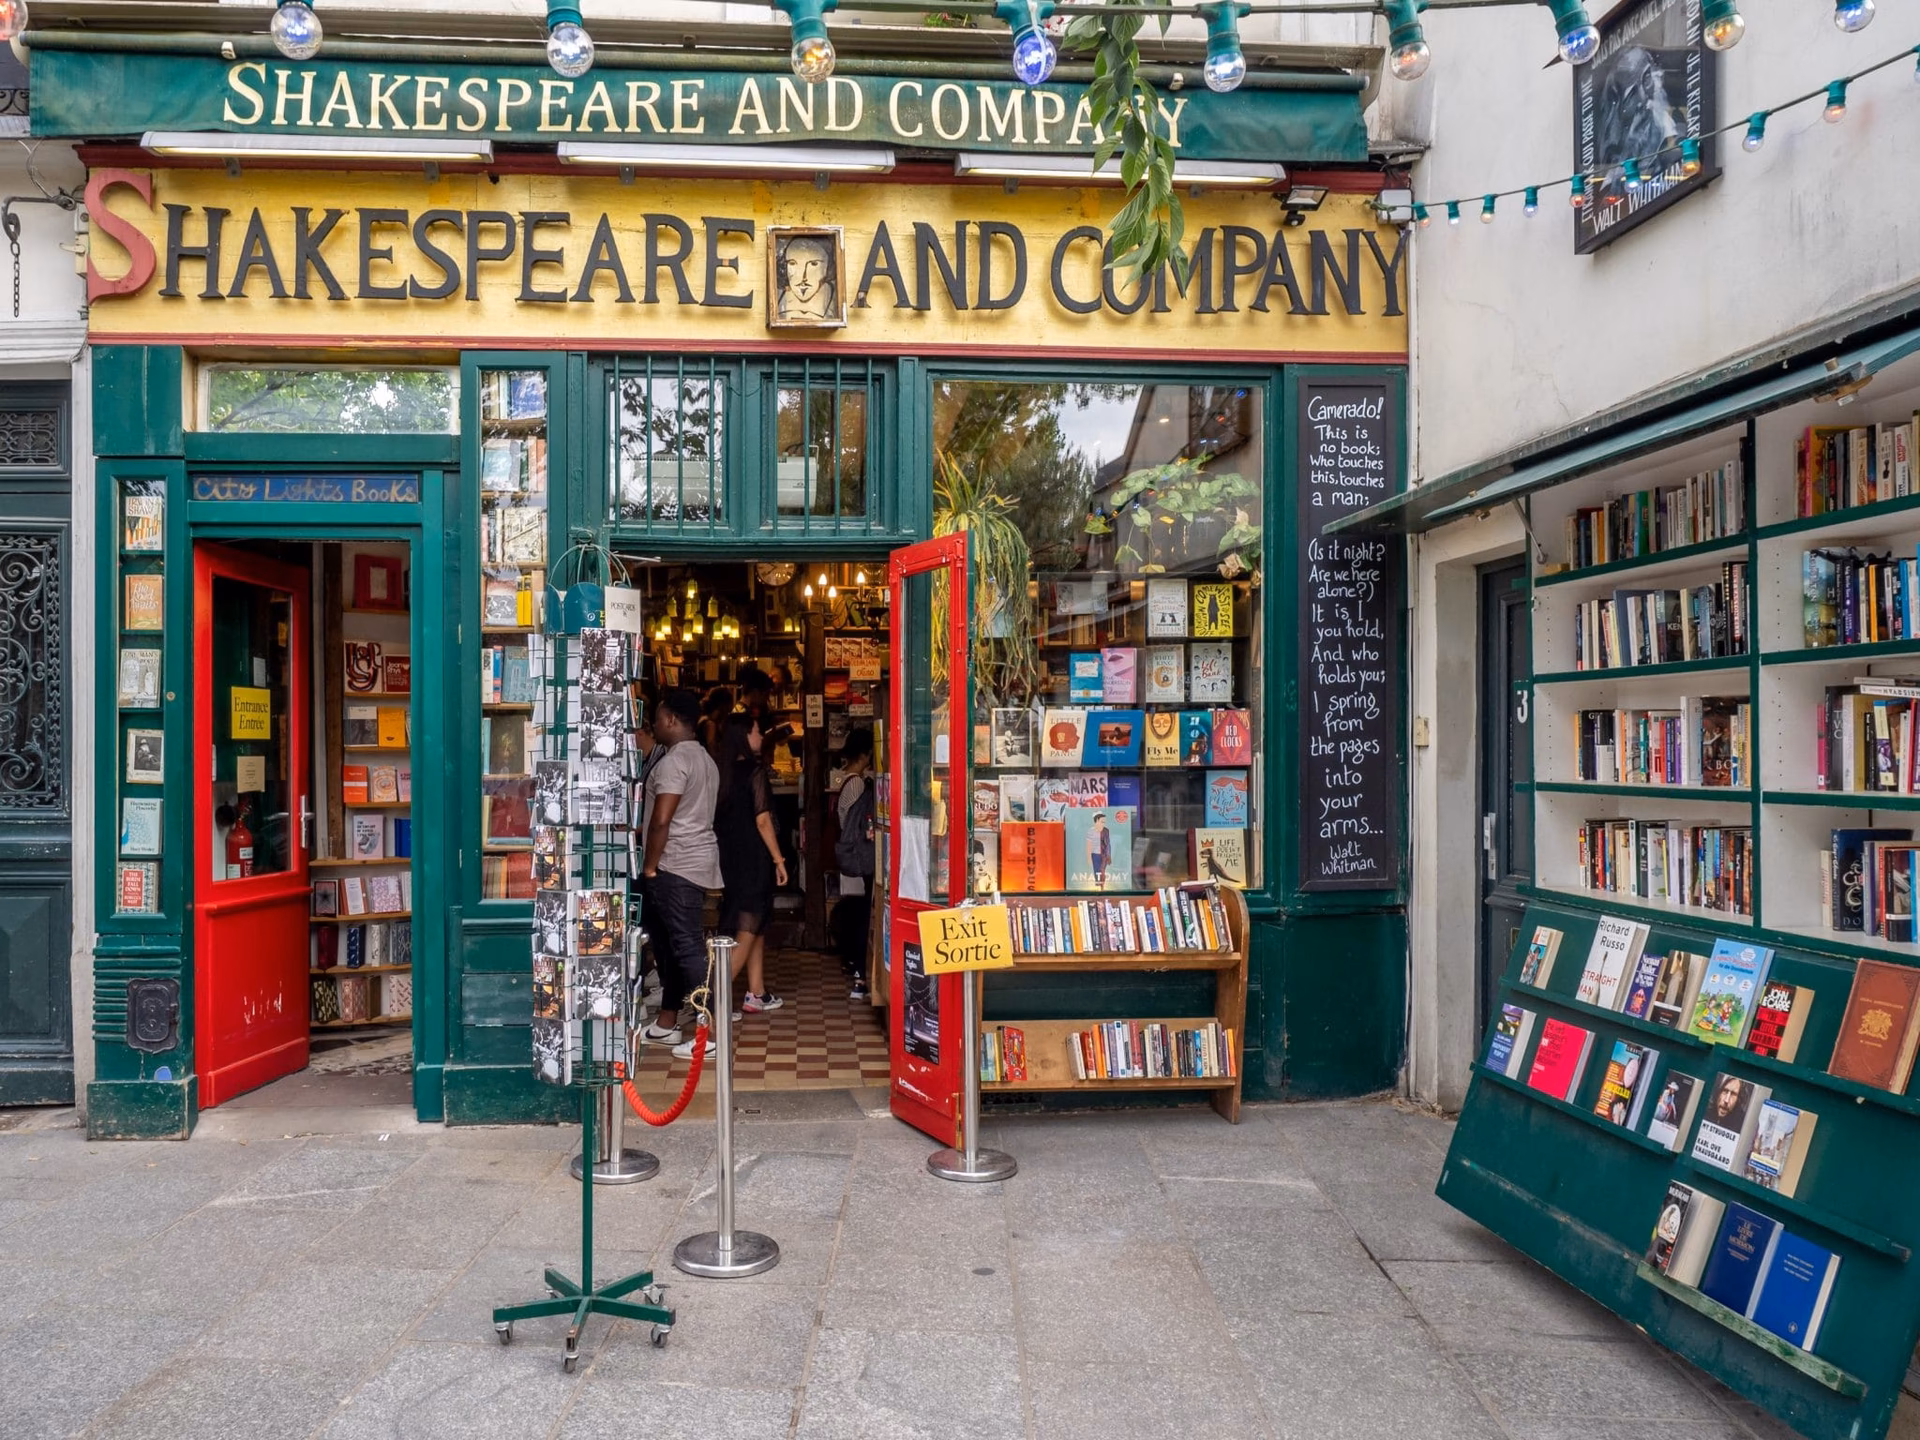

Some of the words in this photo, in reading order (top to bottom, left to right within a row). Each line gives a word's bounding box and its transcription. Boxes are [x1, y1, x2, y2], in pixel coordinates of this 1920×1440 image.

[223, 61, 706, 135] SHAKESPEARE
[728, 76, 865, 136] AND
[1593, 197, 1625, 235] WALT
[87, 167, 755, 309] SHAKESPEARE
[850, 218, 1028, 313] AND
[1307, 395, 1384, 421] Camerado!
[1314, 424, 1347, 441] This
[1355, 425, 1368, 439] is
[1320, 444, 1336, 453] no
[1341, 442, 1380, 455] book;
[1309, 455, 1335, 467] Who
[1338, 455, 1384, 470] touches
[193, 477, 257, 500] City
[1311, 470, 1338, 486] this,
[1339, 472, 1385, 488] touches
[1312, 492, 1323, 506] a
[1332, 491, 1370, 506] man;
[1308, 538, 1324, 562] (Is
[1328, 540, 1340, 560] it
[1343, 540, 1386, 567] night?
[1308, 565, 1331, 583] Are
[1334, 570, 1350, 582] we
[1351, 566, 1381, 582] here
[1317, 581, 1374, 602] alone?)
[1312, 603, 1324, 623] It
[1335, 603, 1349, 621] is
[1313, 628, 1342, 645] you
[1346, 619, 1385, 640] hold,
[1311, 644, 1344, 663] And
[1352, 642, 1379, 660] who
[1318, 663, 1356, 685] holds
[1359, 669, 1386, 692] you;
[234, 697, 268, 714] Entrance
[1328, 691, 1379, 719] spring
[1516, 690, 1529, 723] 3
[239, 714, 265, 730] Entrée
[1225, 725, 1238, 736] RED
[1323, 712, 1364, 738] from
[1147, 746, 1162, 756] Fly
[1165, 747, 1179, 755] Me
[1220, 736, 1243, 748] CLOCKS
[1310, 736, 1335, 756] the
[1340, 738, 1379, 764] pages
[1070, 777, 1107, 795] MARS
[1325, 765, 1362, 788] into
[975, 801, 998, 811] RUDO
[1319, 793, 1363, 819] your
[1319, 816, 1384, 839] arms...
[1219, 839, 1236, 847] LIFE
[1330, 841, 1362, 860] Walt
[1225, 859, 1239, 867] ME
[1321, 858, 1377, 876] Whitman
[1071, 872, 1130, 882] ANATOMY
[942, 916, 988, 941] Exit
[1599, 919, 1631, 937] Richard
[935, 939, 1001, 965] Sortie
[1600, 937, 1626, 951] Russo
[1581, 969, 1618, 988] STRAIGHT
[1770, 988, 1789, 1000] JOHN
[1702, 1123, 1709, 1131] MY
[1710, 1124, 1736, 1142] STRUGGLE
[1695, 1145, 1730, 1165] KNAUSGAARD
[1697, 1138, 1709, 1148] KARL
[1710, 1142, 1722, 1153] OVE
